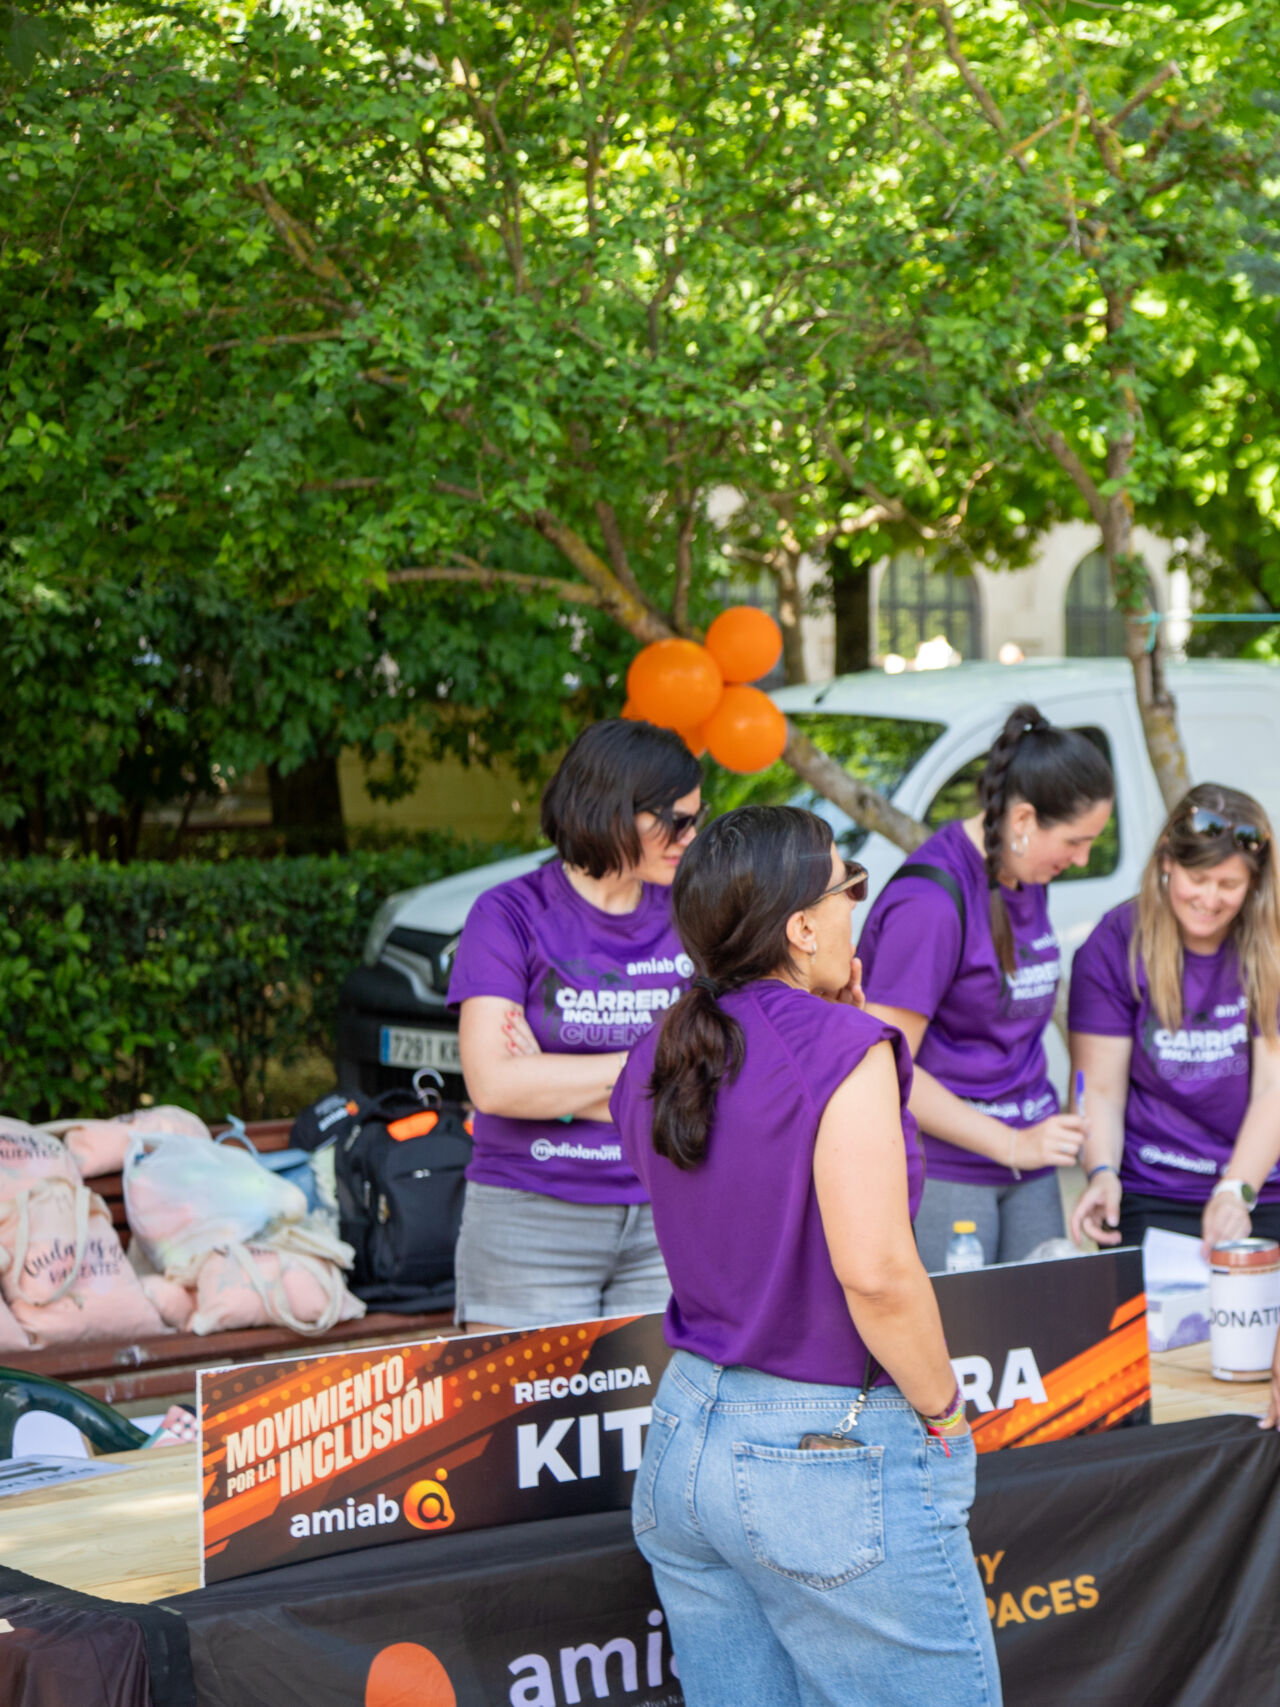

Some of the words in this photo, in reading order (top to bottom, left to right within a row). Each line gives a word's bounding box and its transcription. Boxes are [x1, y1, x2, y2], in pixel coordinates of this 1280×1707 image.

[626, 957, 675, 976] amiab
[560, 1023, 654, 1046] CUEN
[562, 1009, 652, 1025] INCLUSIVA
[514, 1364, 651, 1405] RECOGIDA
[227, 1355, 404, 1474] MOVIMIENTO
[227, 1472, 256, 1498] POR
[258, 1458, 276, 1483] LA
[279, 1375, 444, 1498] INCLUSIÓN
[517, 1405, 653, 1489] KIT
[950, 1346, 1049, 1413] RA
[289, 1493, 400, 1539] amiab
[507, 1608, 681, 1707] ami
